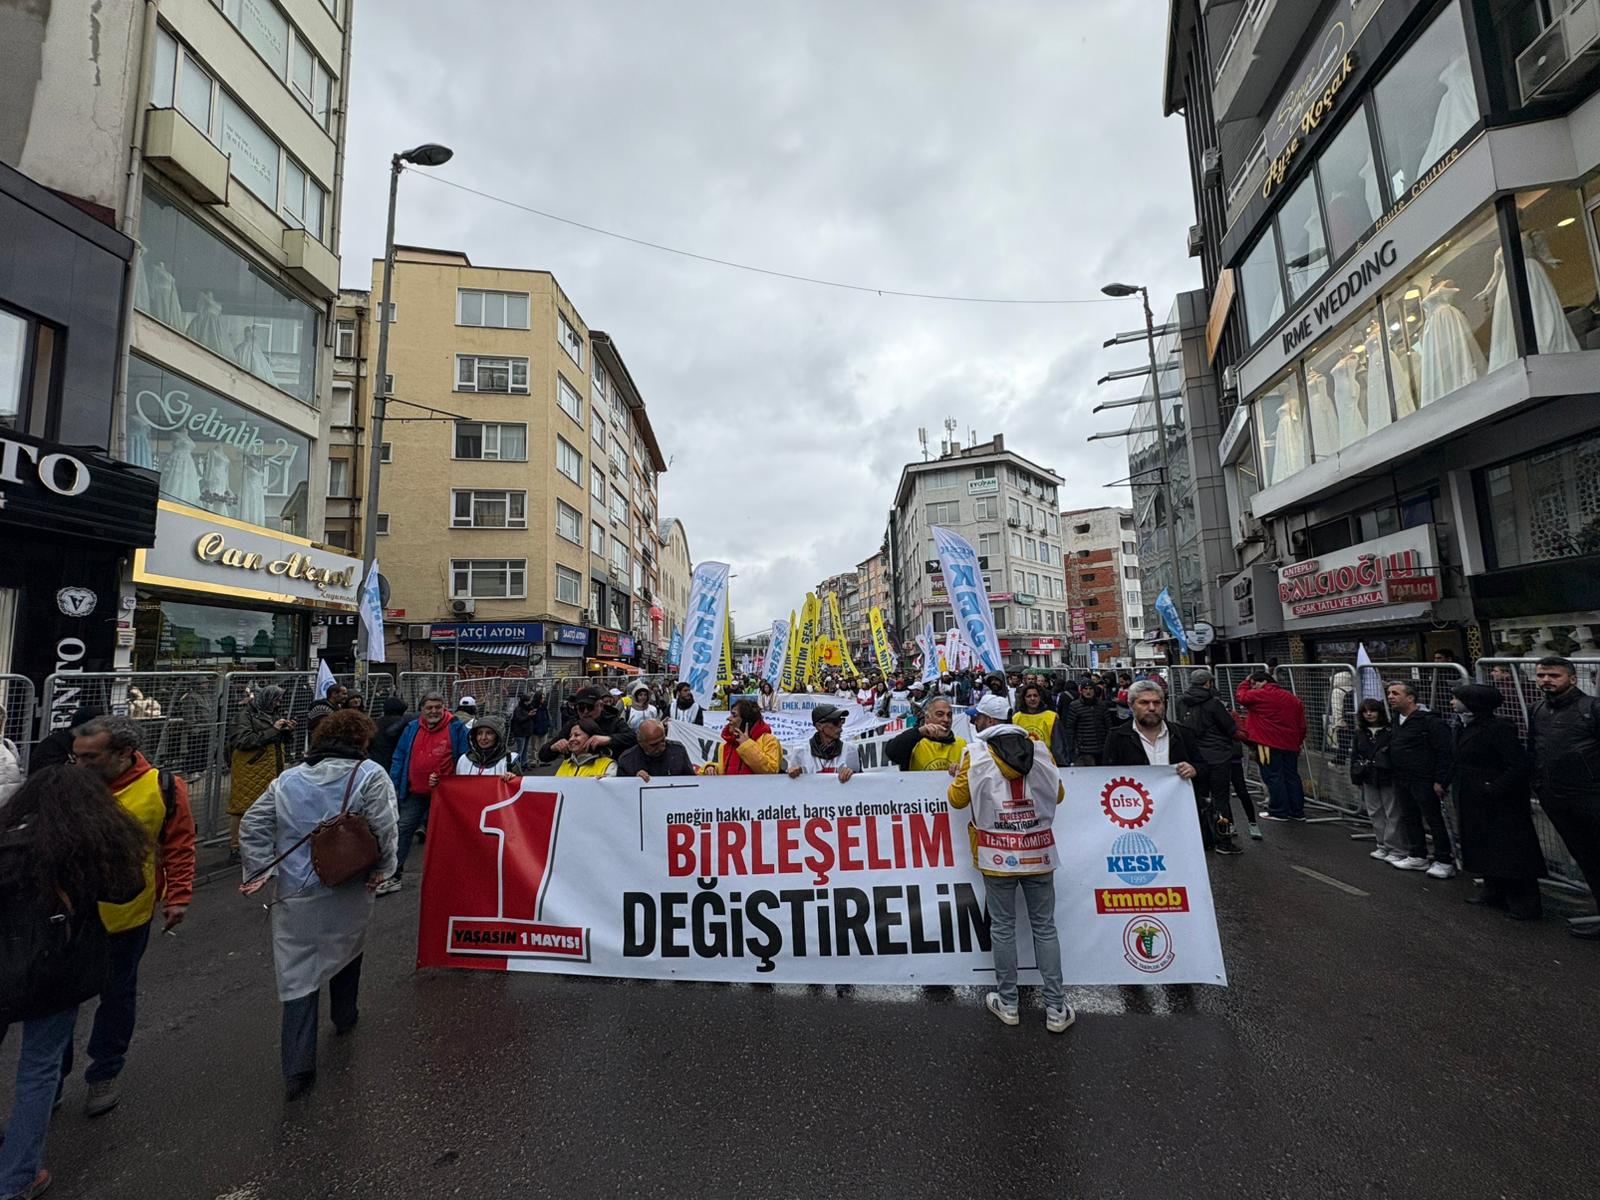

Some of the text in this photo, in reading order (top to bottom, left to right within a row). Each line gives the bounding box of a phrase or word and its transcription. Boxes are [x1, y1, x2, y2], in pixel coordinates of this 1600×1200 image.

[1263, 137, 1299, 198] Ayşe
[1301, 52, 1353, 135] Koçak
[1375, 148, 1458, 231] Haute Couture
[1313, 239, 1397, 325] WEDDING
[136, 390, 264, 456] Gelinlik
[1317, 600, 1338, 613] TATLI
[1339, 598, 1350, 610] VE
[1351, 592, 1383, 606] BAKLA
[1390, 582, 1433, 598] TATLICI
[490, 627, 526, 637] AYDIN
[688, 592, 717, 694] KESK
[666, 798, 949, 827] emeğin hakkı, adalet, barış ve demokrasi için
[1111, 793, 1142, 808] DİSK
[666, 812, 955, 886] BİRLEŞELİM
[1107, 854, 1167, 873] KESK
[1102, 887, 1182, 908] tmmob
[454, 929, 580, 949] YAŞASIN 1 MAYIS!
